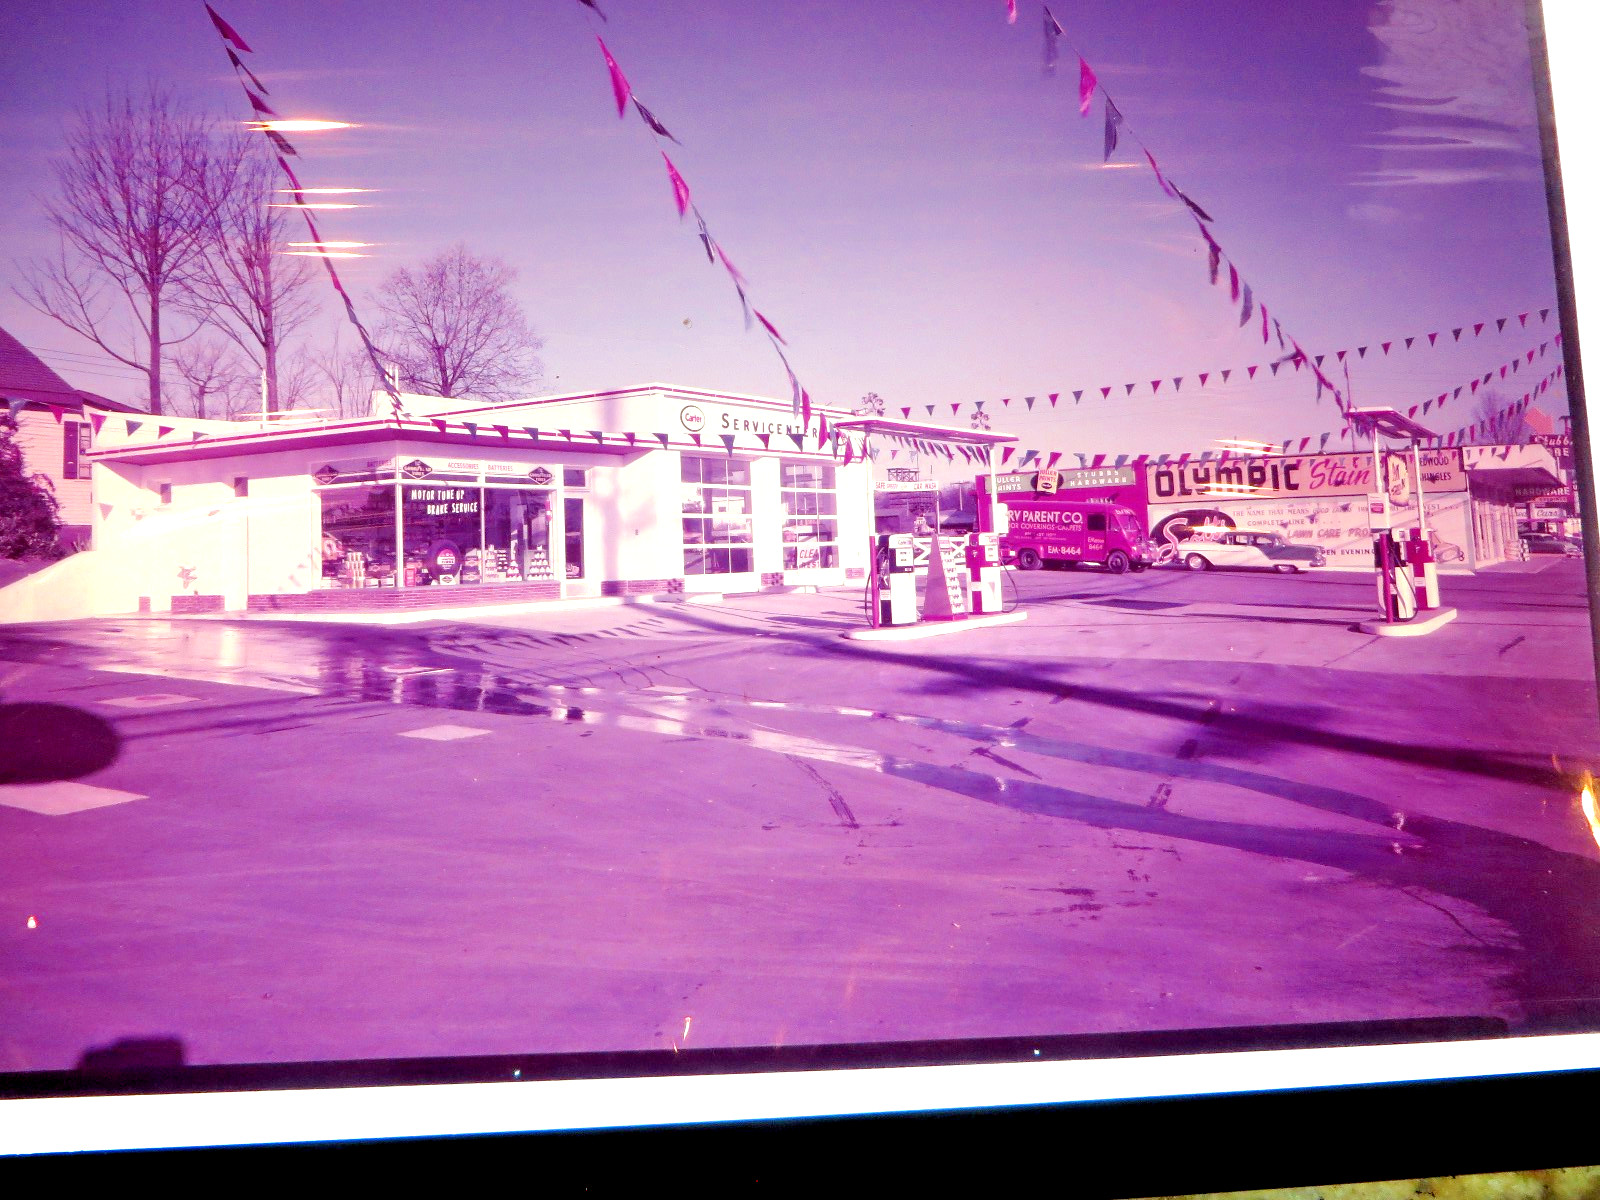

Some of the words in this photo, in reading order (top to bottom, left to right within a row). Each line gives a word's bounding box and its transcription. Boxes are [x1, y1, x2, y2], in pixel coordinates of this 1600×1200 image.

[684, 412, 702, 423] Carter
[1419, 456, 1449, 466] EDWOOD
[447, 462, 479, 470] ACCESSORIES
[487, 464, 514, 472] BATTERIES
[1076, 470, 1119, 479] STUBBS
[1309, 458, 1371, 490] Stain
[1420, 472, 1451, 481] HINGLES
[996, 475, 1021, 484] ULLER
[1070, 476, 1127, 487] HARDWARE
[997, 483, 1022, 491] AINTS
[411, 489, 435, 501] MOTOR
[437, 489, 455, 501] TUNE
[456, 489, 465, 501] UP
[426, 503, 449, 516] BRAKE
[451, 501, 478, 514] SERVICE
[1287, 507, 1310, 515] MEANS
[1007, 509, 1021, 522] RY
[1022, 510, 1061, 523] PARENT
[1288, 518, 1305, 526] LINE
[1316, 528, 1341, 538] CARE
